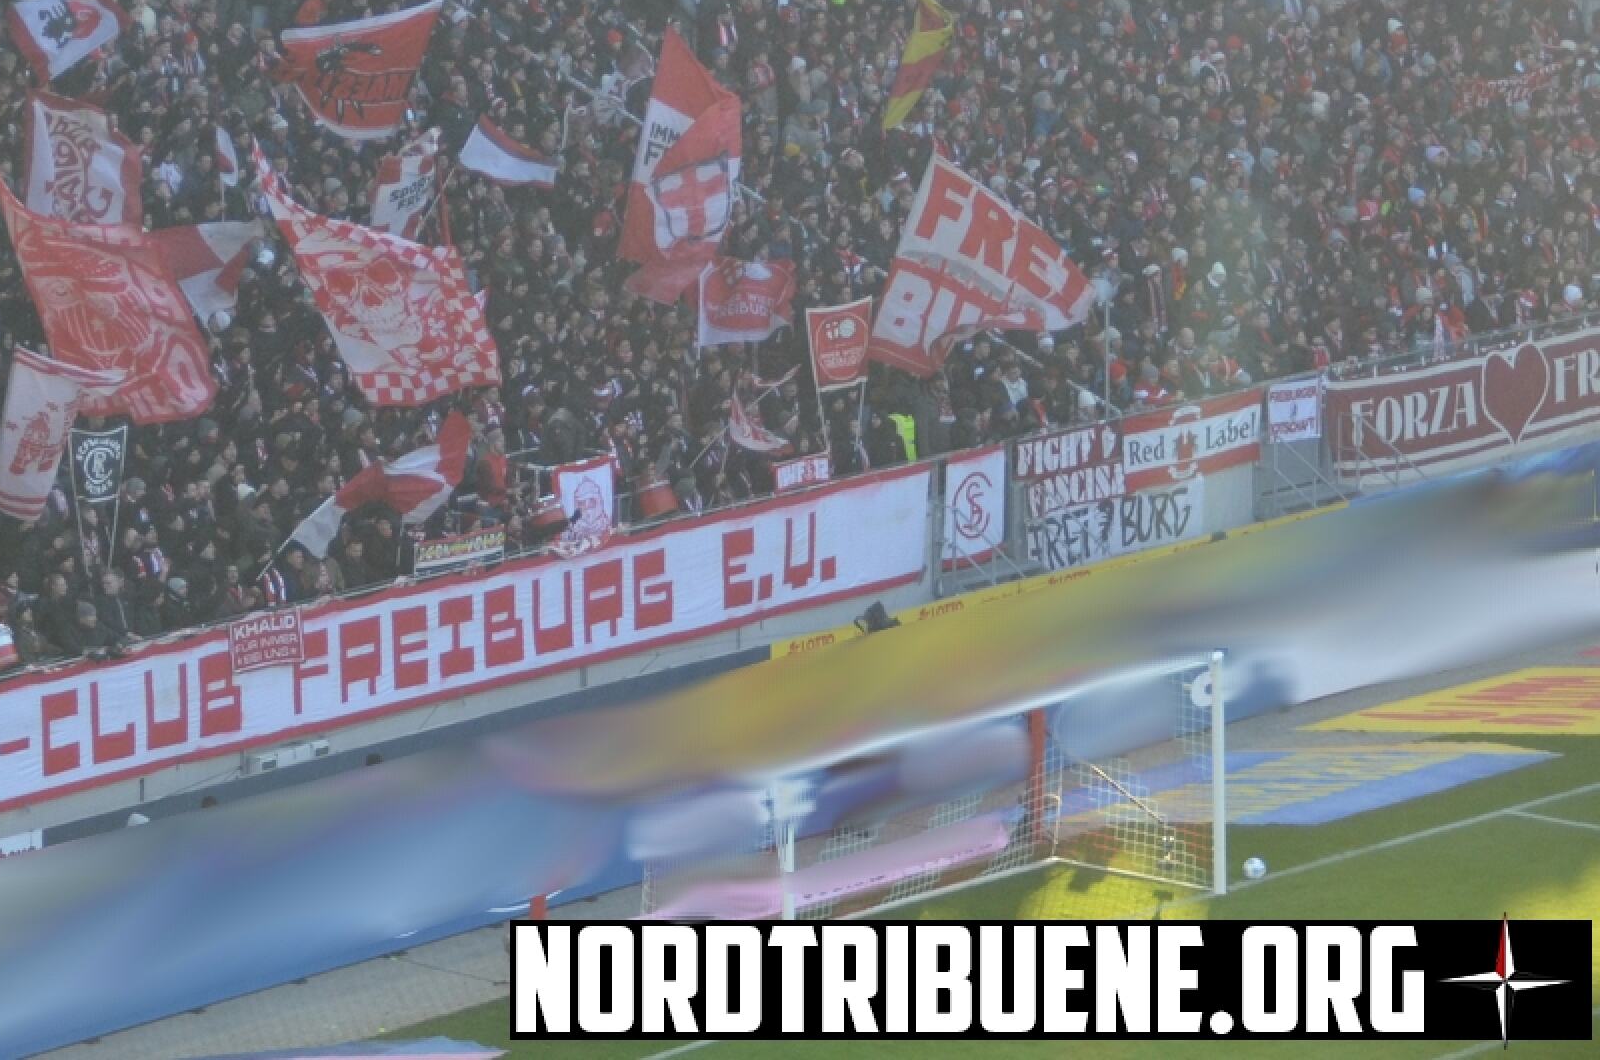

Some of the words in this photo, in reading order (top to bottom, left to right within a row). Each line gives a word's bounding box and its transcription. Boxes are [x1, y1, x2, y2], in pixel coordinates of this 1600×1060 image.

[912, 171, 1096, 320] FREI
[1129, 435, 1165, 466] Red
[1205, 412, 1259, 450] Label
[1351, 380, 1478, 448] FORZA
[1120, 486, 1193, 548] BURG
[233, 616, 295, 641] KHALID
[293, 548, 673, 715] FREIBURG
